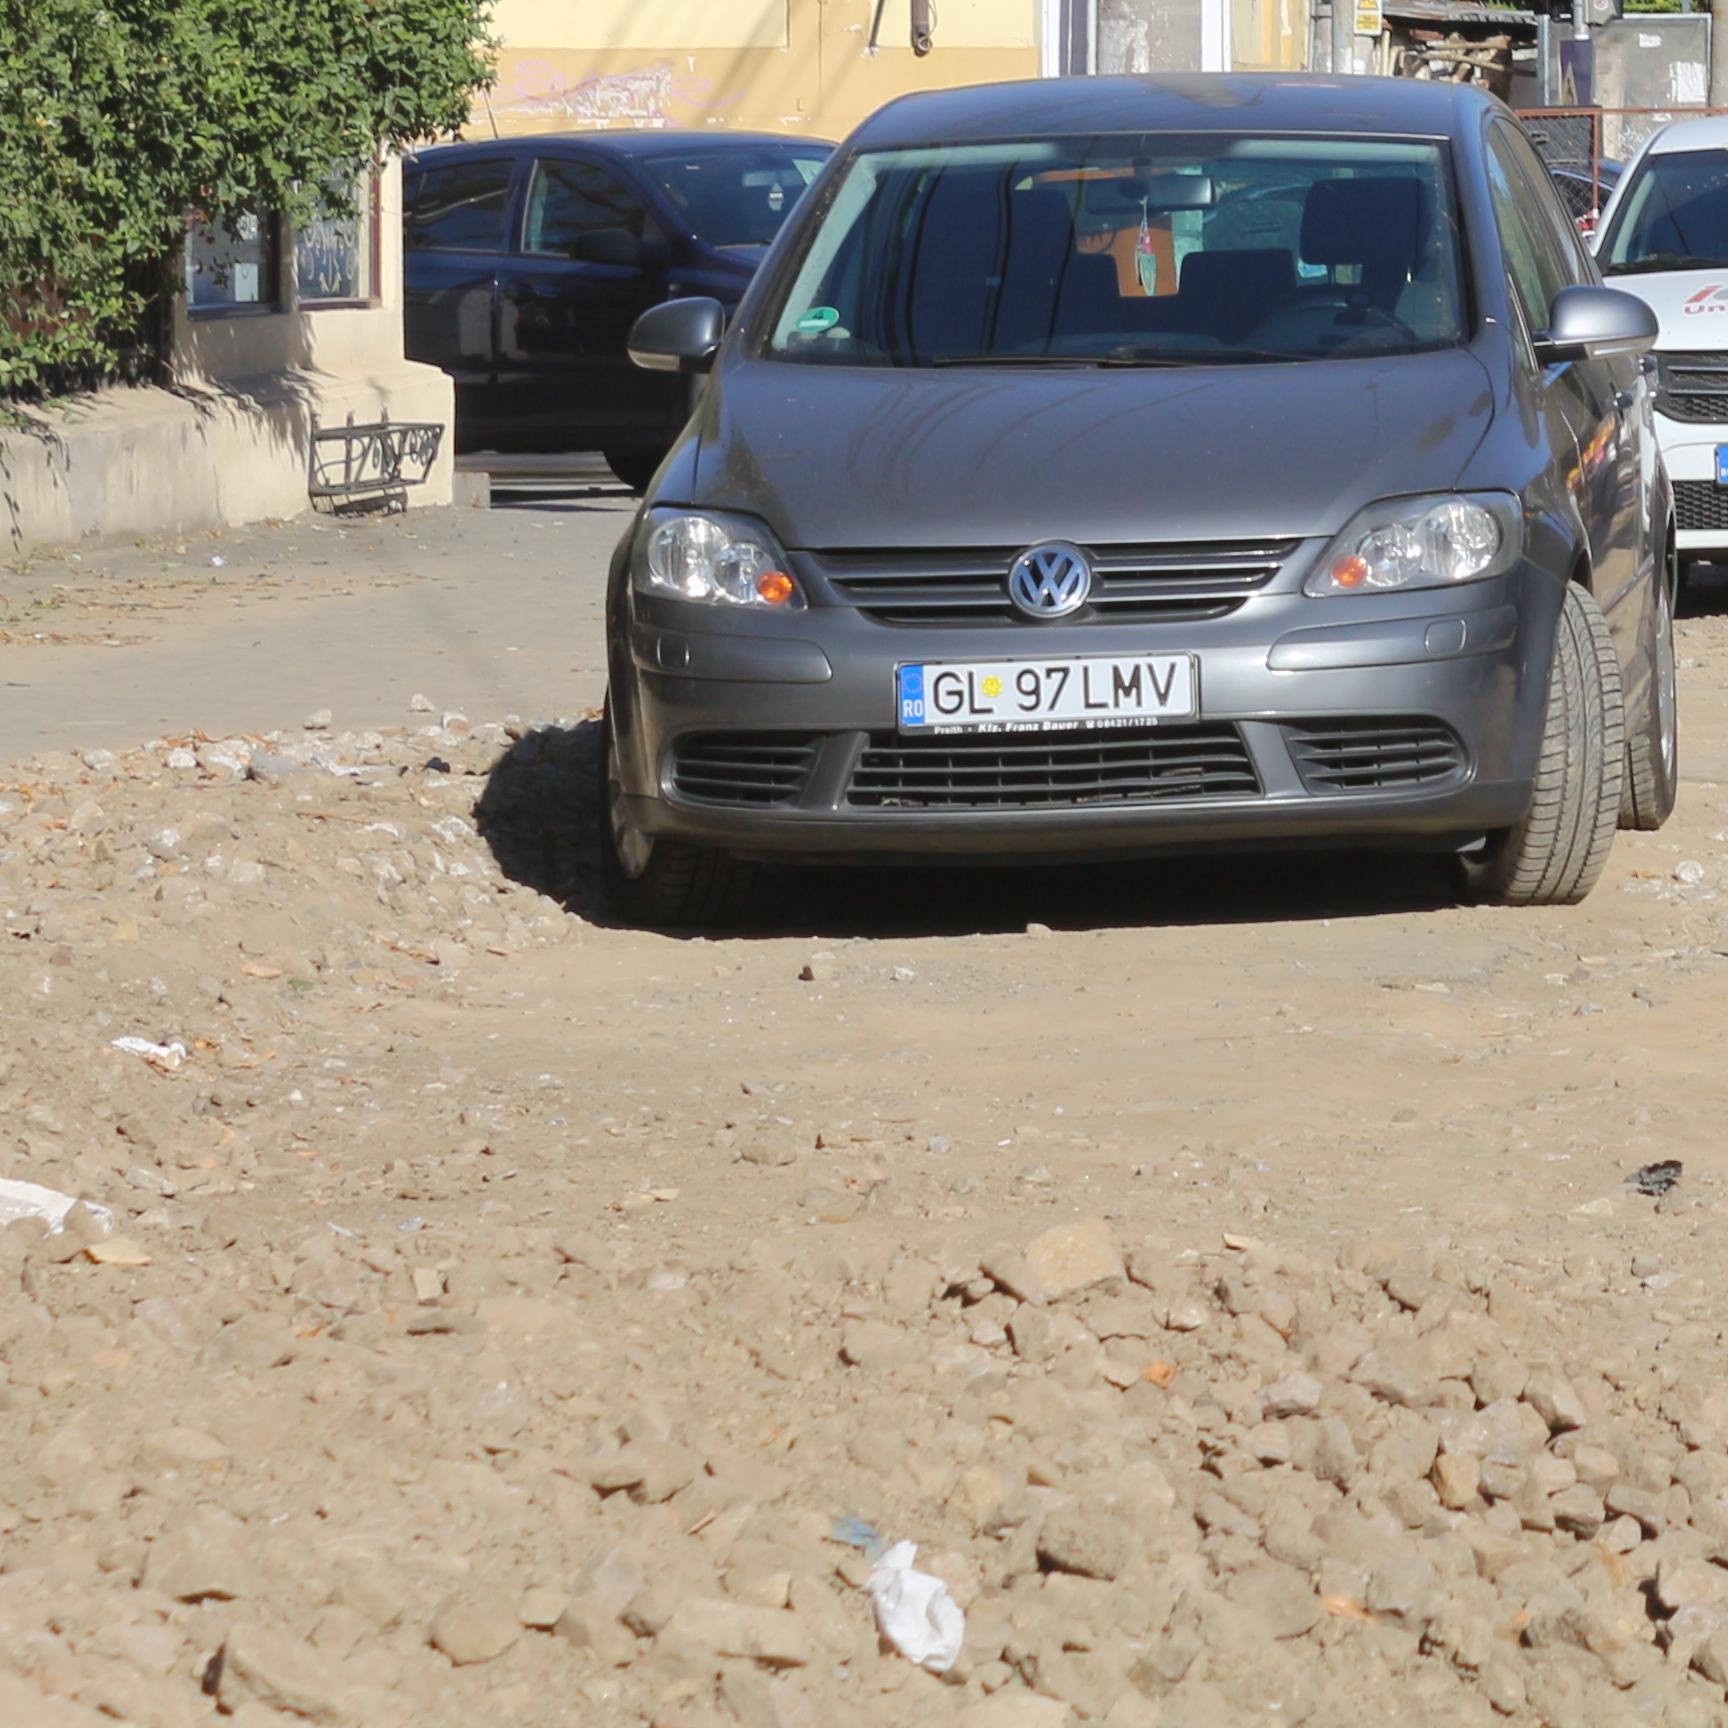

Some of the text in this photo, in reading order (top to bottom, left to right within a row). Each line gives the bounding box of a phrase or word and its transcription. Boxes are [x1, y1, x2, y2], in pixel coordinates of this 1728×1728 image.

[1684, 302, 1725, 315] Un
[933, 662, 1177, 715] GL 97 LMV
[903, 699, 923, 718] RO
[1005, 721, 1040, 733] Franz
